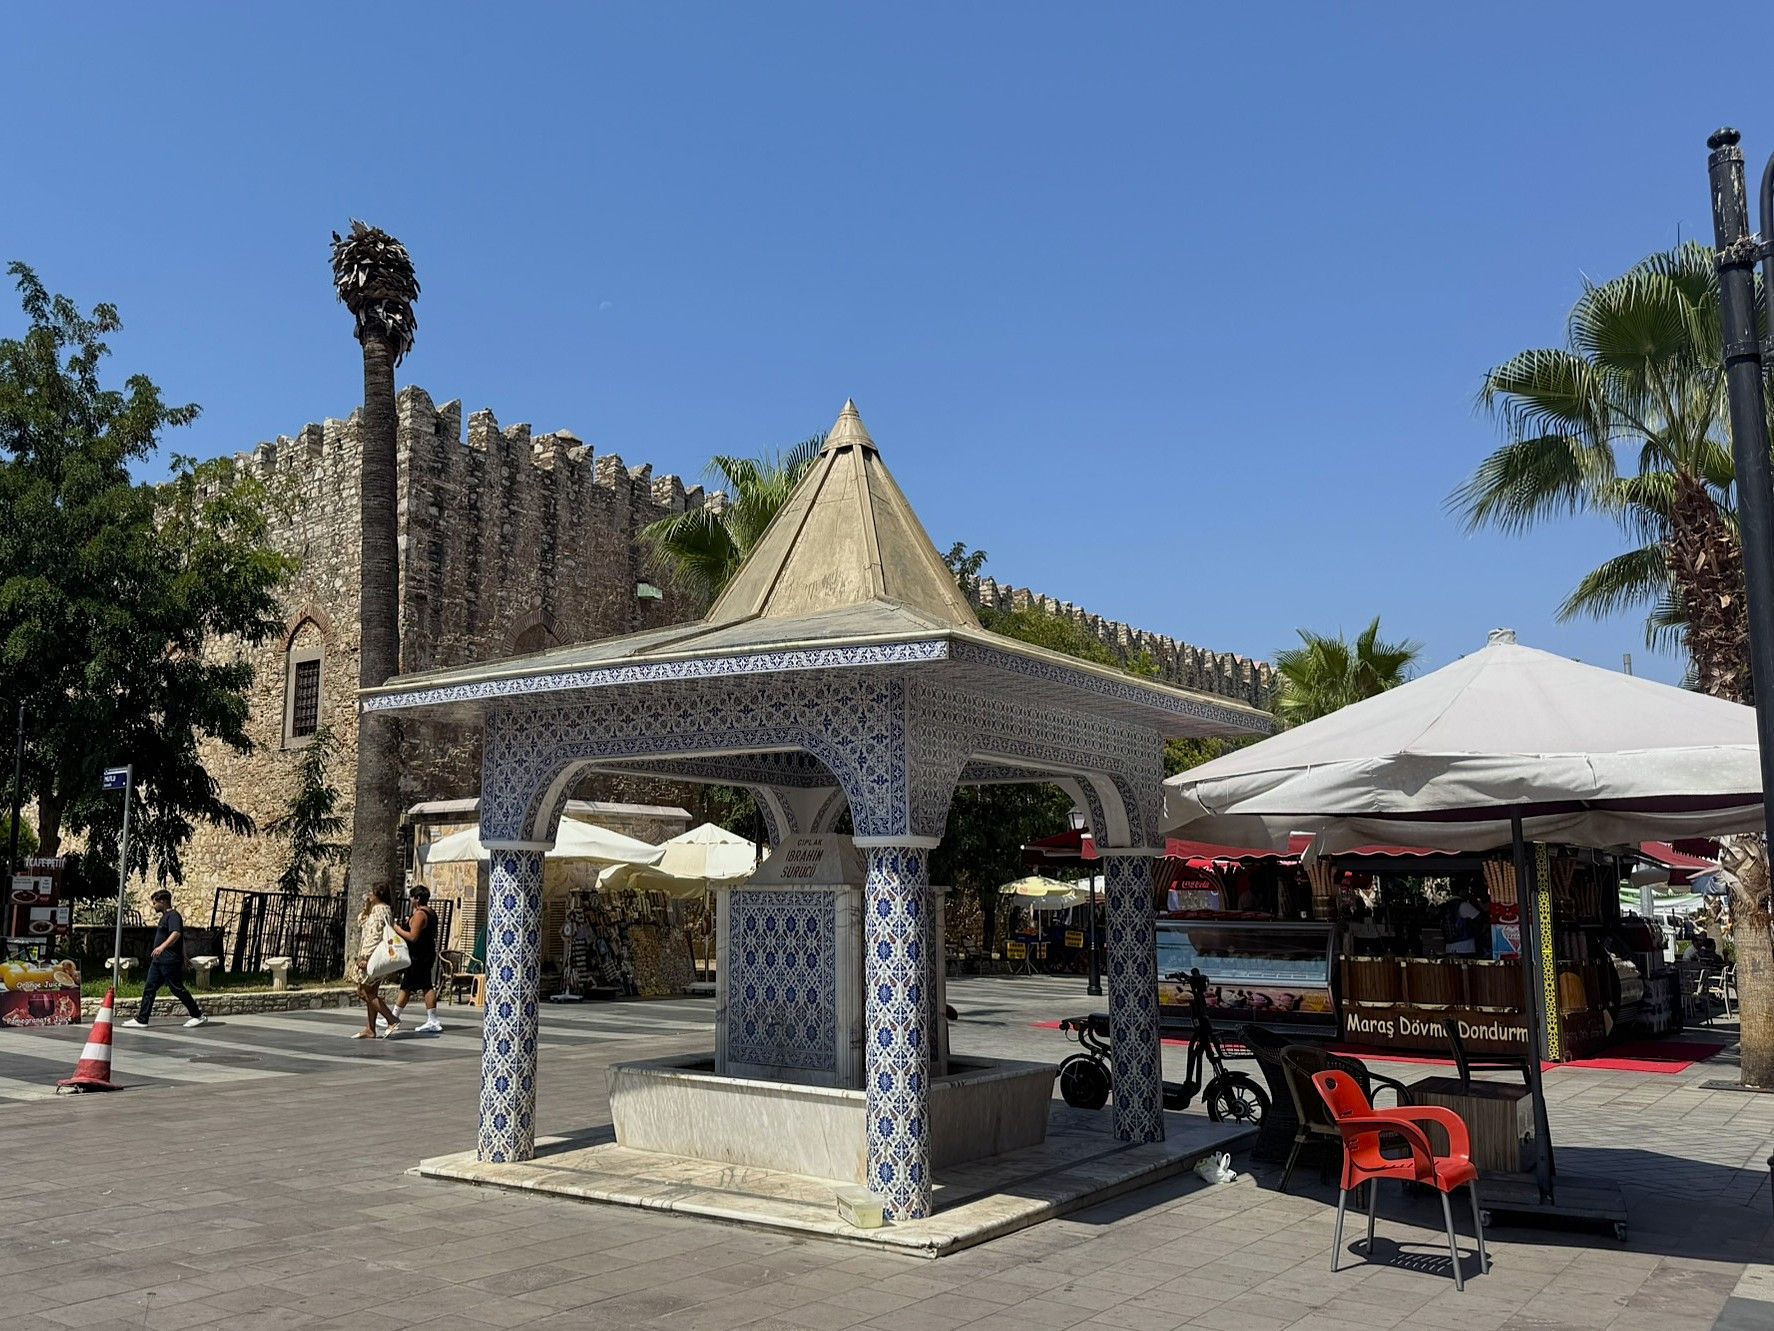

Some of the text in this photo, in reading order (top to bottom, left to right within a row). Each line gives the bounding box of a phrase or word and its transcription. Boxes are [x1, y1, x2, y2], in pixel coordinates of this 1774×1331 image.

[785, 847, 824, 862] İBRAHİM
[16, 980, 62, 990] Orange Juice
[1347, 1013, 1394, 1038] Maraş
[1458, 1020, 1529, 1043] Dondurm
